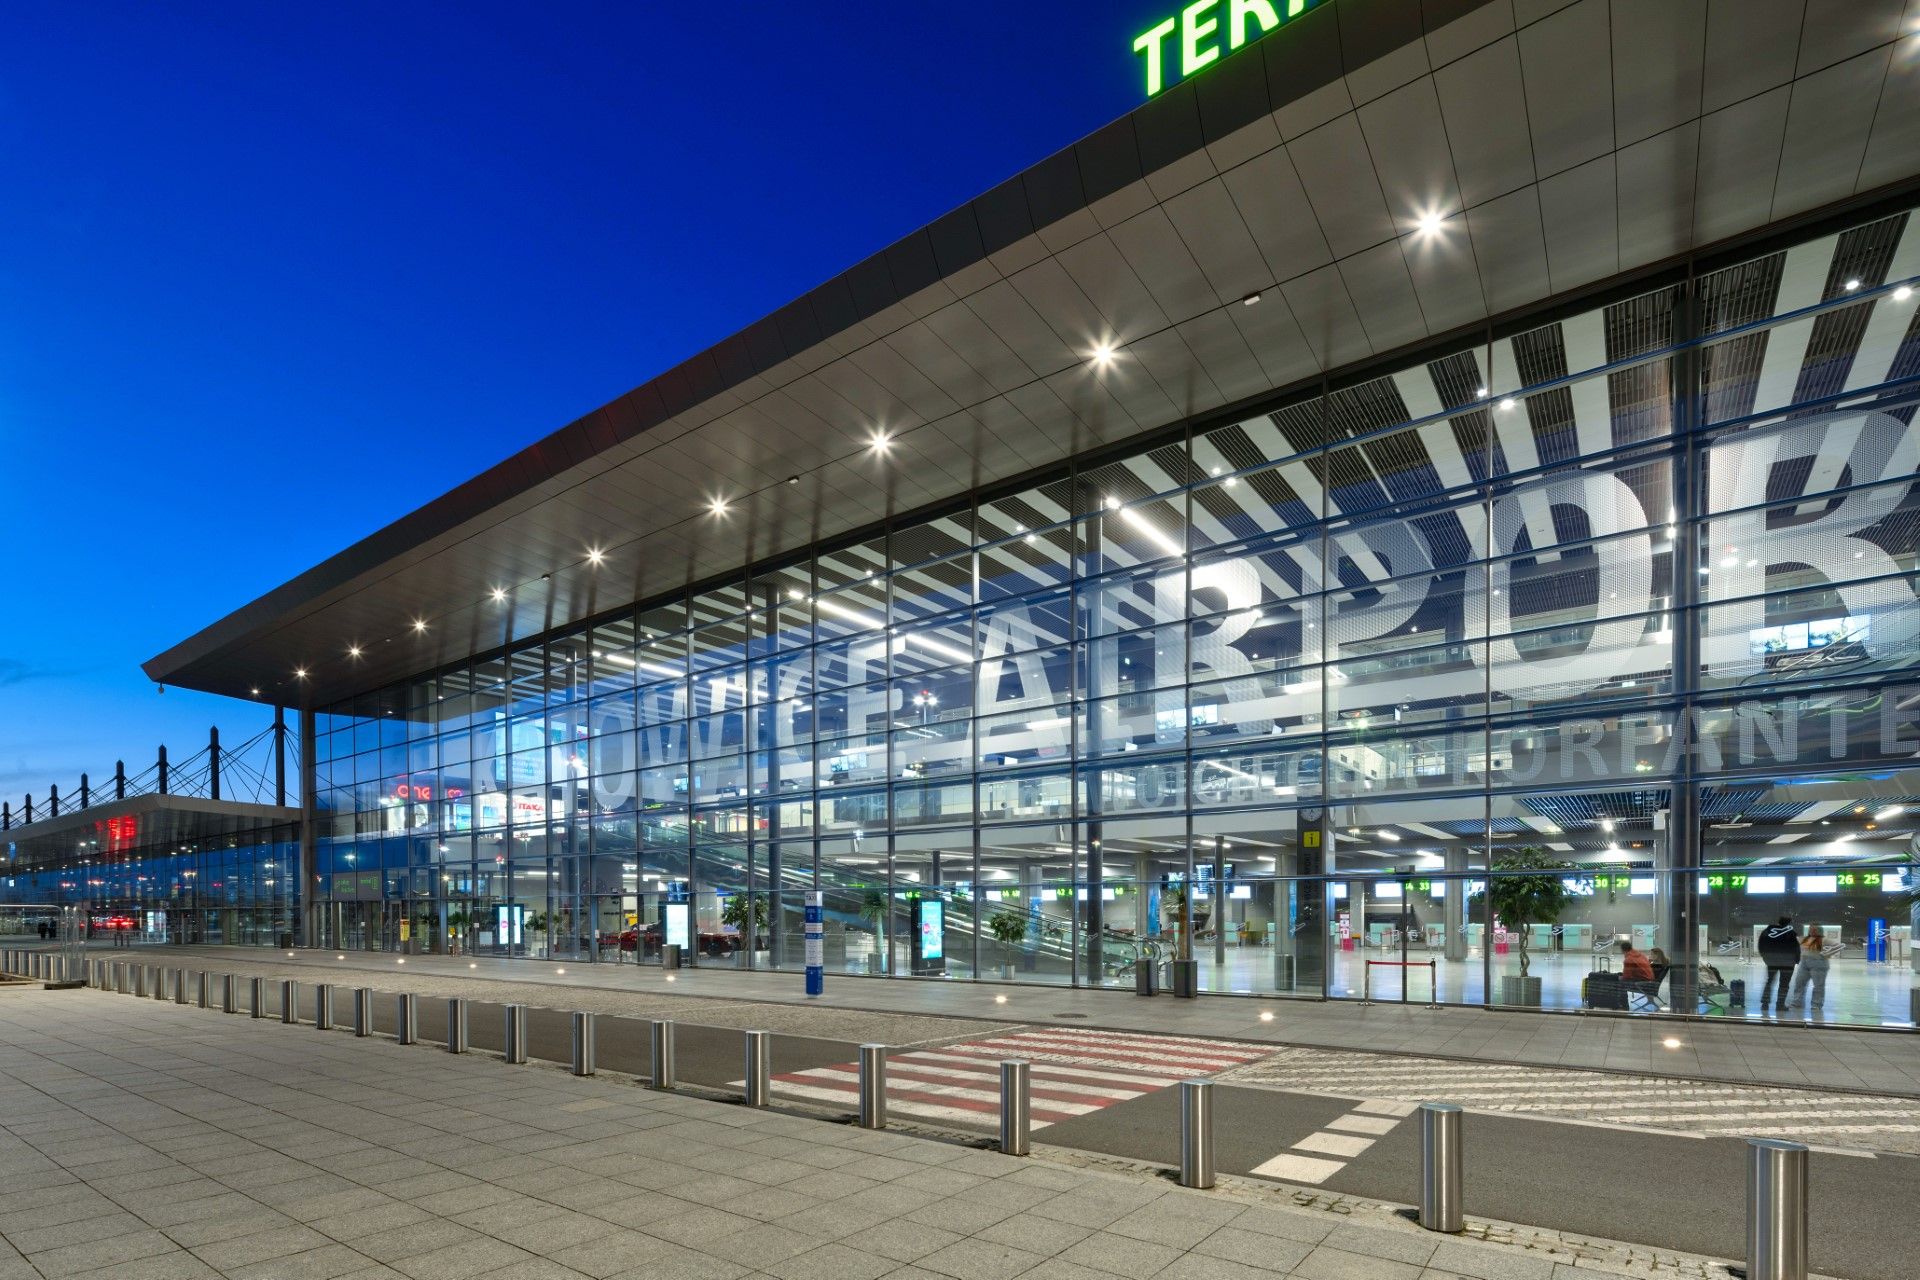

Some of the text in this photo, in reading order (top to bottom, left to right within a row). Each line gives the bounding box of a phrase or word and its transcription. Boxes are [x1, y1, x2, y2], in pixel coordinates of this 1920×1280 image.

[1133, 0, 1305, 97] TER
[1595, 878, 1608, 888] 30
[1616, 878, 1629, 888] 29
[1709, 876, 1723, 886] 28
[1732, 876, 1746, 886] 27
[1838, 874, 1854, 884] 26
[1864, 874, 1880, 884] 25
